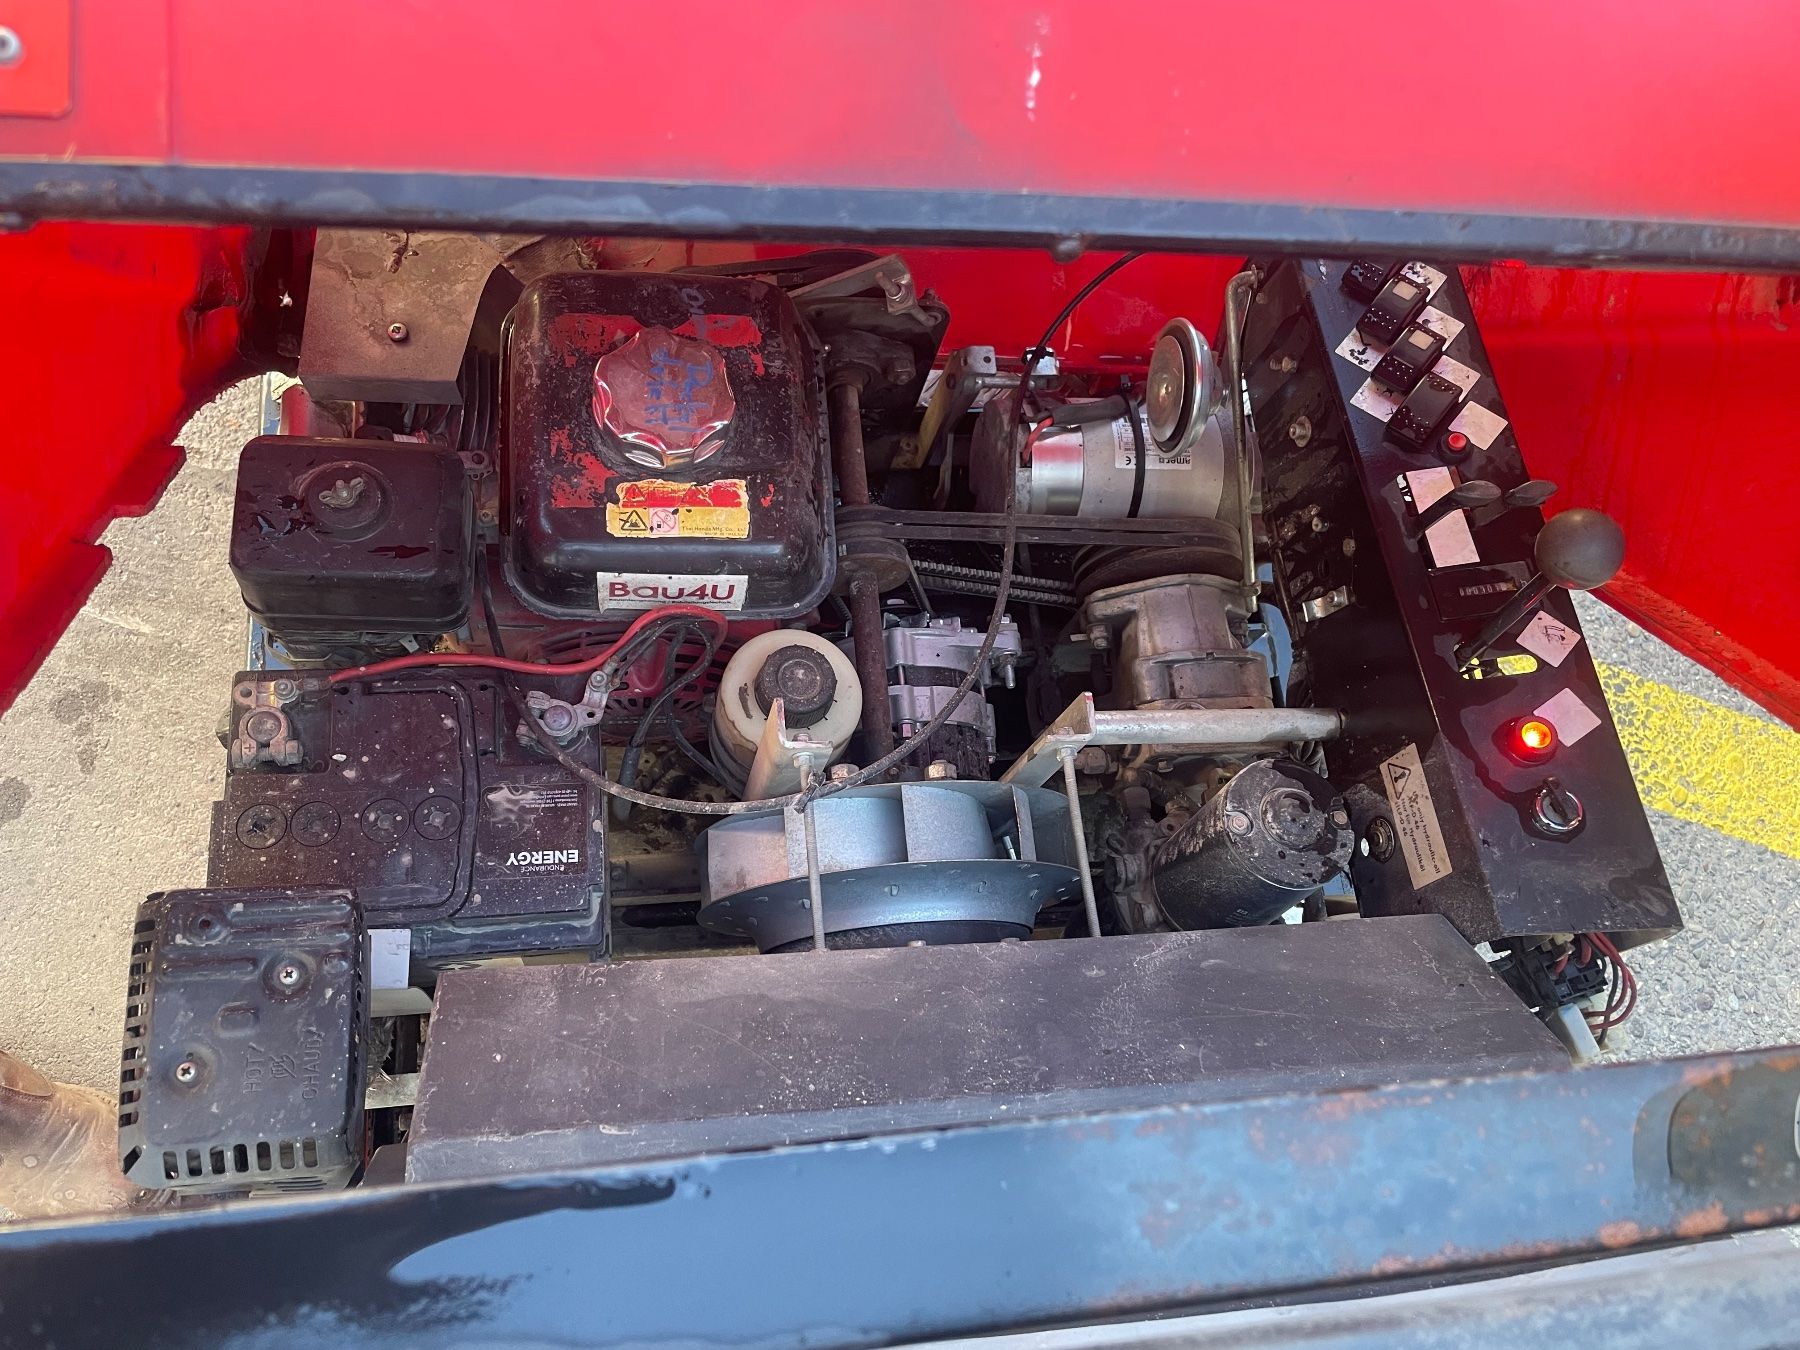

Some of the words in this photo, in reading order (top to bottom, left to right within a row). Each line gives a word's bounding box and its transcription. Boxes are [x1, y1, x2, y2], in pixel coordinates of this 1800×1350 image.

[608, 582, 736, 600] Bau4U
[1416, 807, 1424, 823] only
[506, 849, 579, 866] ENERGY
[520, 864, 565, 873] ENDURANCE
